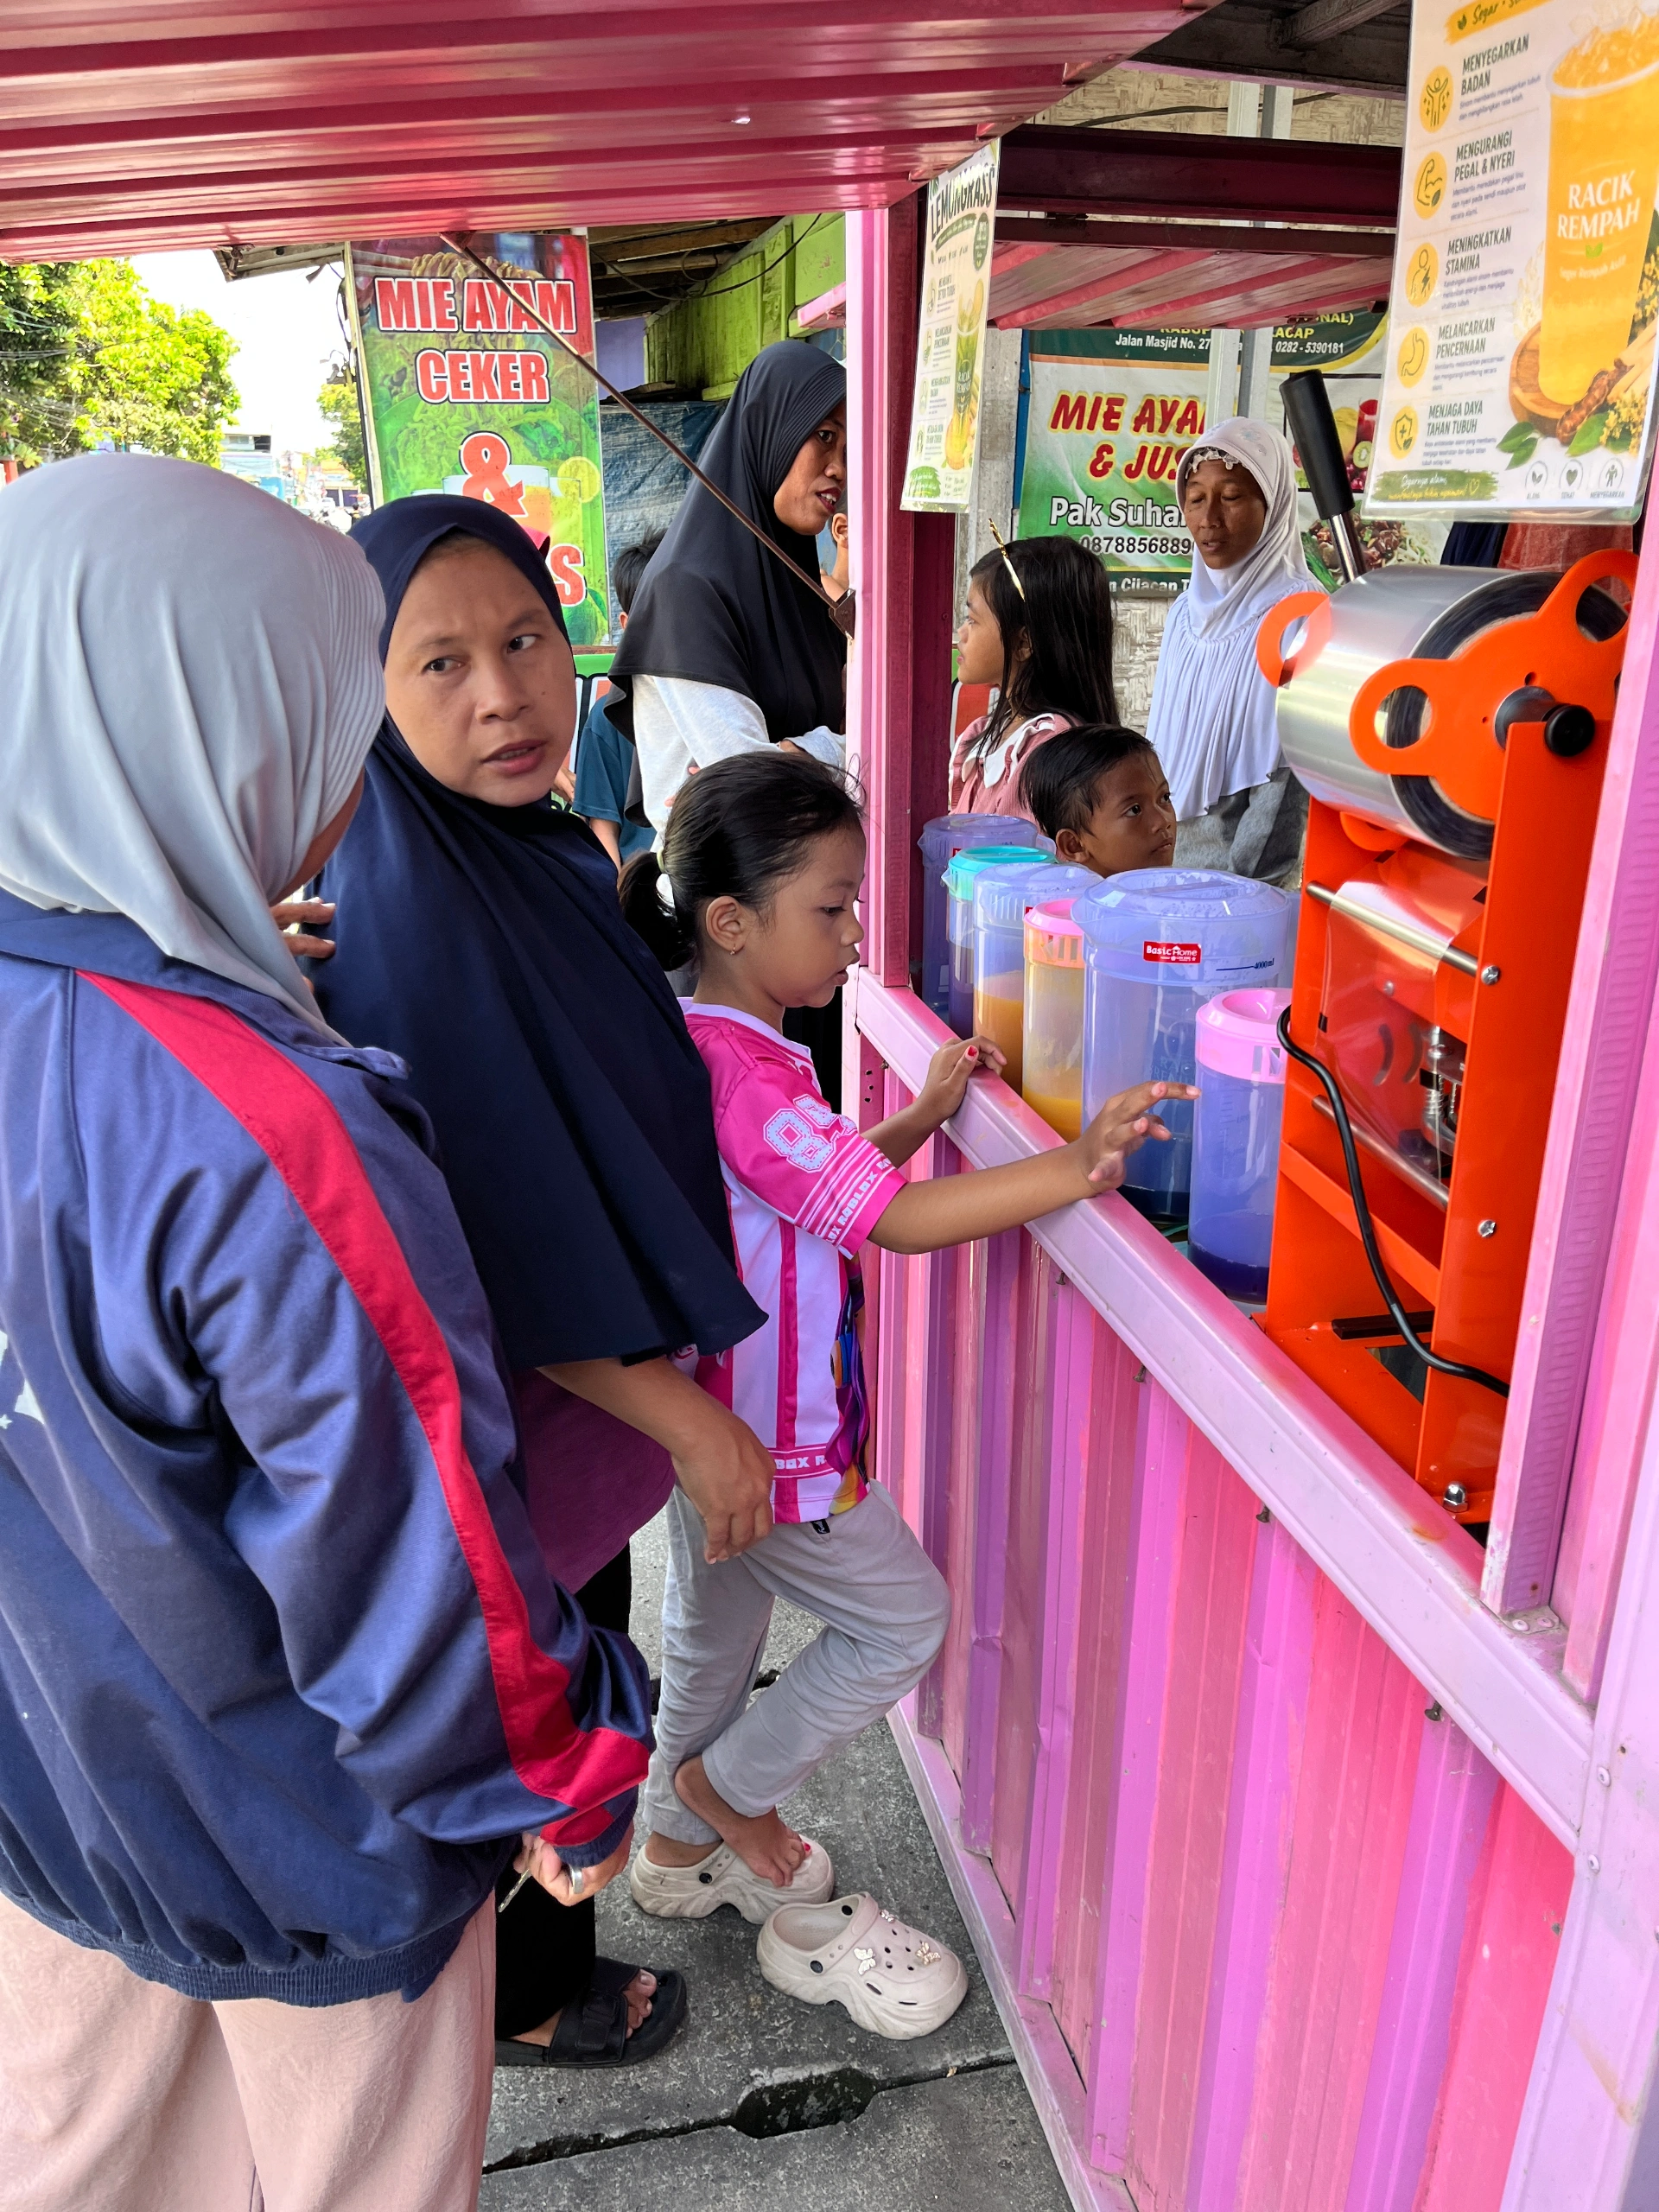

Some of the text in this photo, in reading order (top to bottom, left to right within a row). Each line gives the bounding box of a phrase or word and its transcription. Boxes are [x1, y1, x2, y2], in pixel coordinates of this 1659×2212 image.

[1462, 33, 1529, 75] MENYEGARKAN
[1460, 69, 1491, 96] BADAN
[1456, 130, 1513, 162] MENGURANGI
[1454, 149, 1516, 182] PEGAL & NYERI
[931, 162, 995, 244] LEMONGRASS
[1568, 169, 1636, 210] RACIK
[1557, 197, 1640, 240] REMPAH
[1447, 226, 1512, 257] MENINGKATKAN
[1446, 254, 1480, 276] STAMINA
[374, 277, 577, 334] MIE AYAM
[1115, 334, 1144, 347] Jalan
[1145, 334, 1178, 352] Masjid
[1179, 337, 1196, 350] No.
[1273, 327, 1315, 340] ACAP
[1438, 317, 1496, 341] MELANCARKAN
[1275, 340, 1299, 353] 0282
[1304, 342, 1344, 354] 5390181
[1436, 338, 1486, 359] PENCERNAAN
[416, 348, 551, 404] CEKER
[1050, 393, 1206, 435] MIE AYA
[1428, 400, 1483, 419] MENJAGA DAYA
[1427, 418, 1478, 436] TAHAN TUBUH
[459, 431, 530, 518] &
[1089, 442, 1116, 479] &
[1050, 496, 1103, 526] Pak
[1081, 536, 1194, 555] 0878856889
[837, 1171, 878, 1226] ROBLOX
